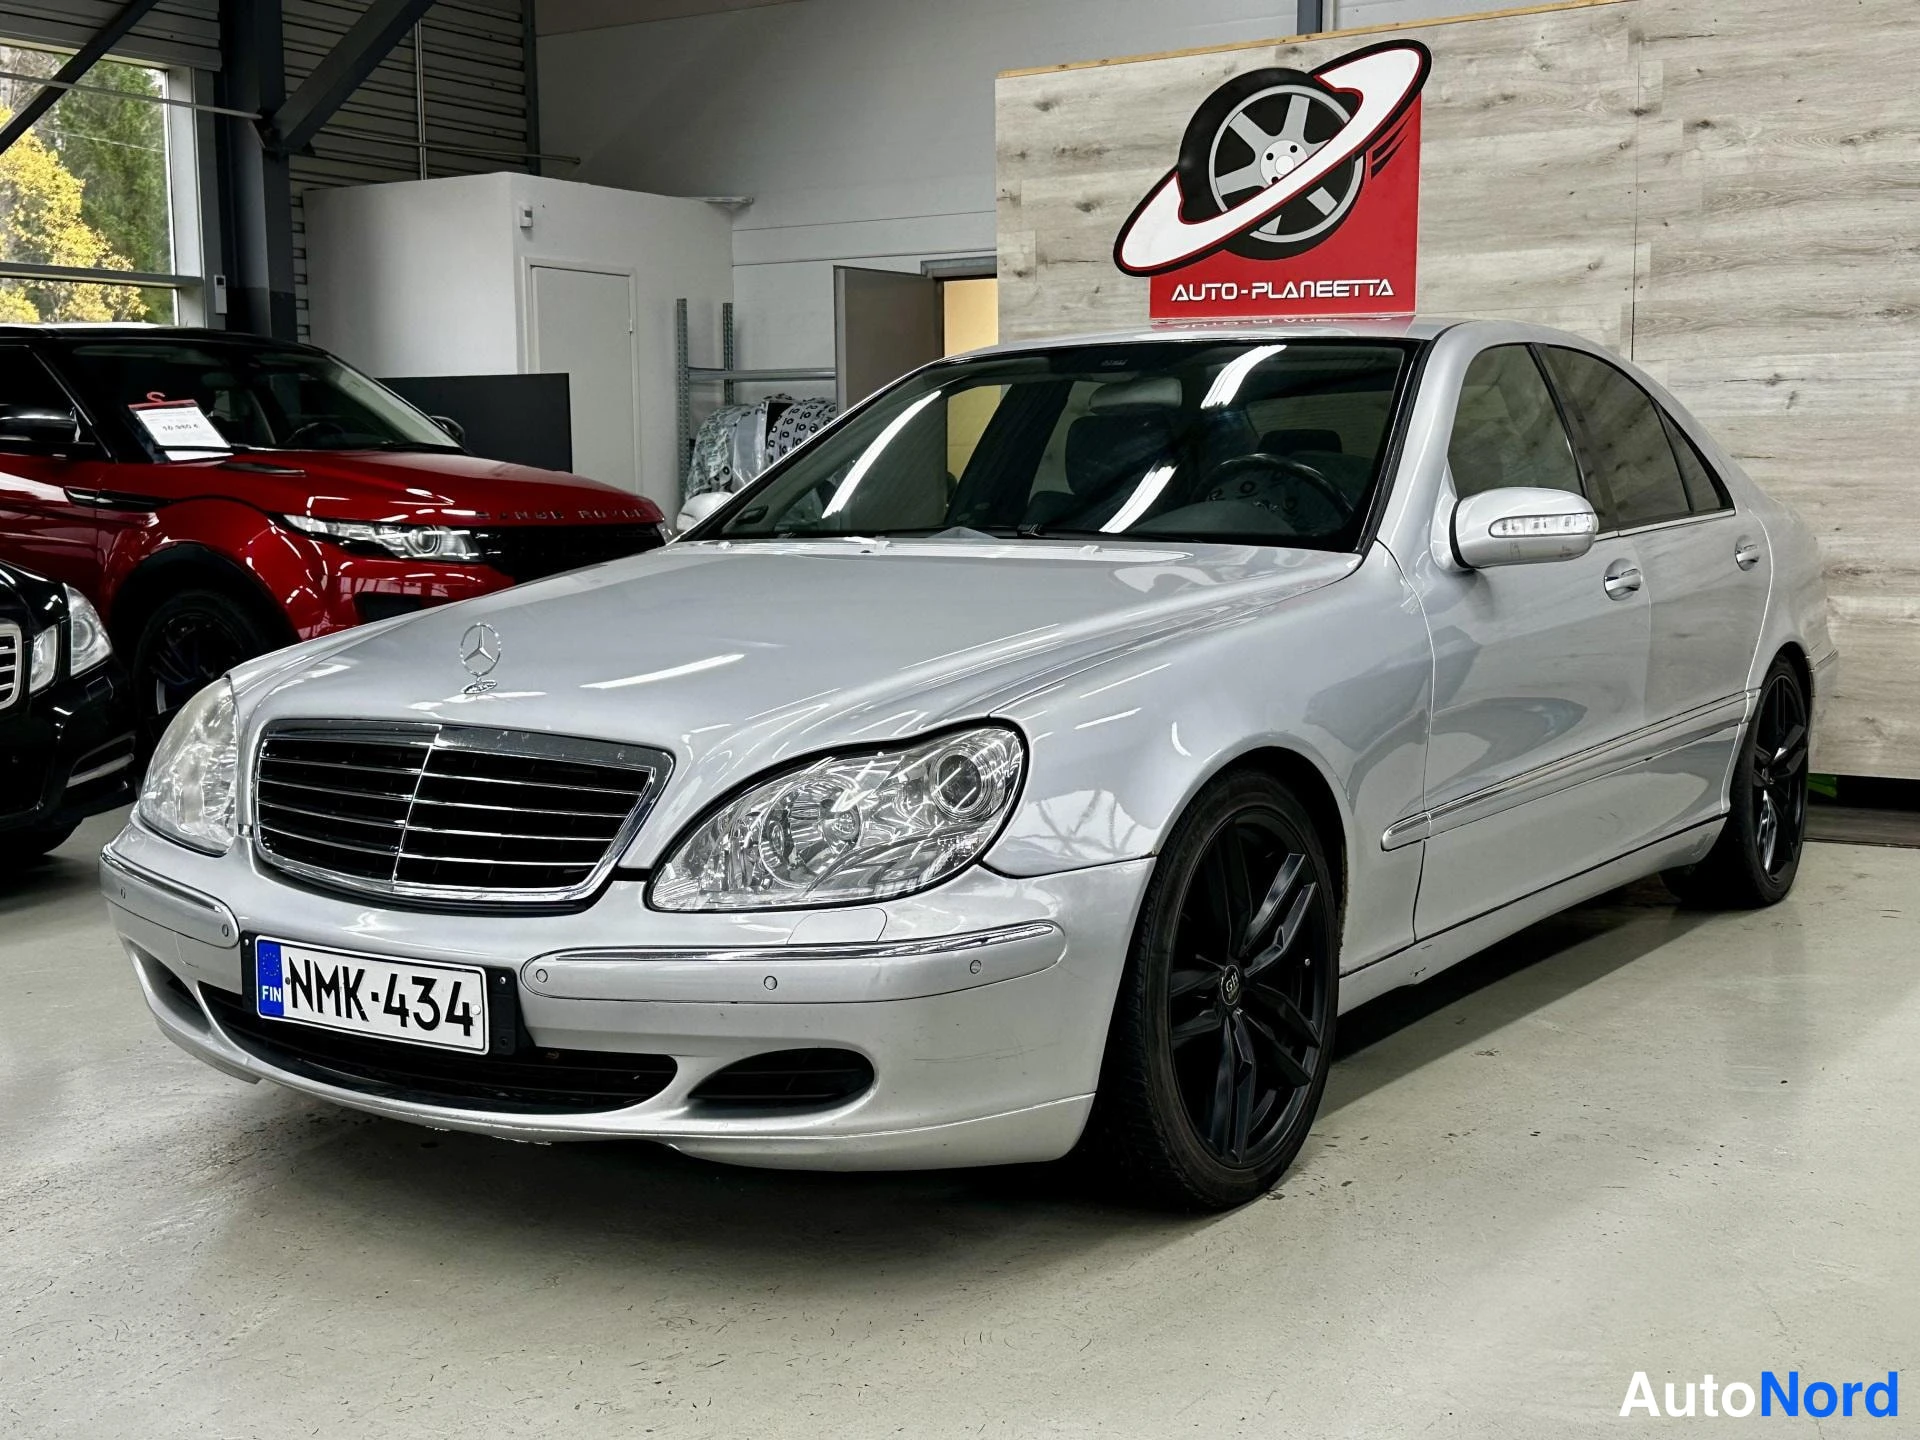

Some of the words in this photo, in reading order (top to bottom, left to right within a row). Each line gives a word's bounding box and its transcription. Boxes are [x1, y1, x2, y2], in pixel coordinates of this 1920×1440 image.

[1171, 278, 1394, 302] AUTO-PLANEETTA
[262, 985, 282, 1003] FIN
[289, 957, 474, 1036] NMK-434
